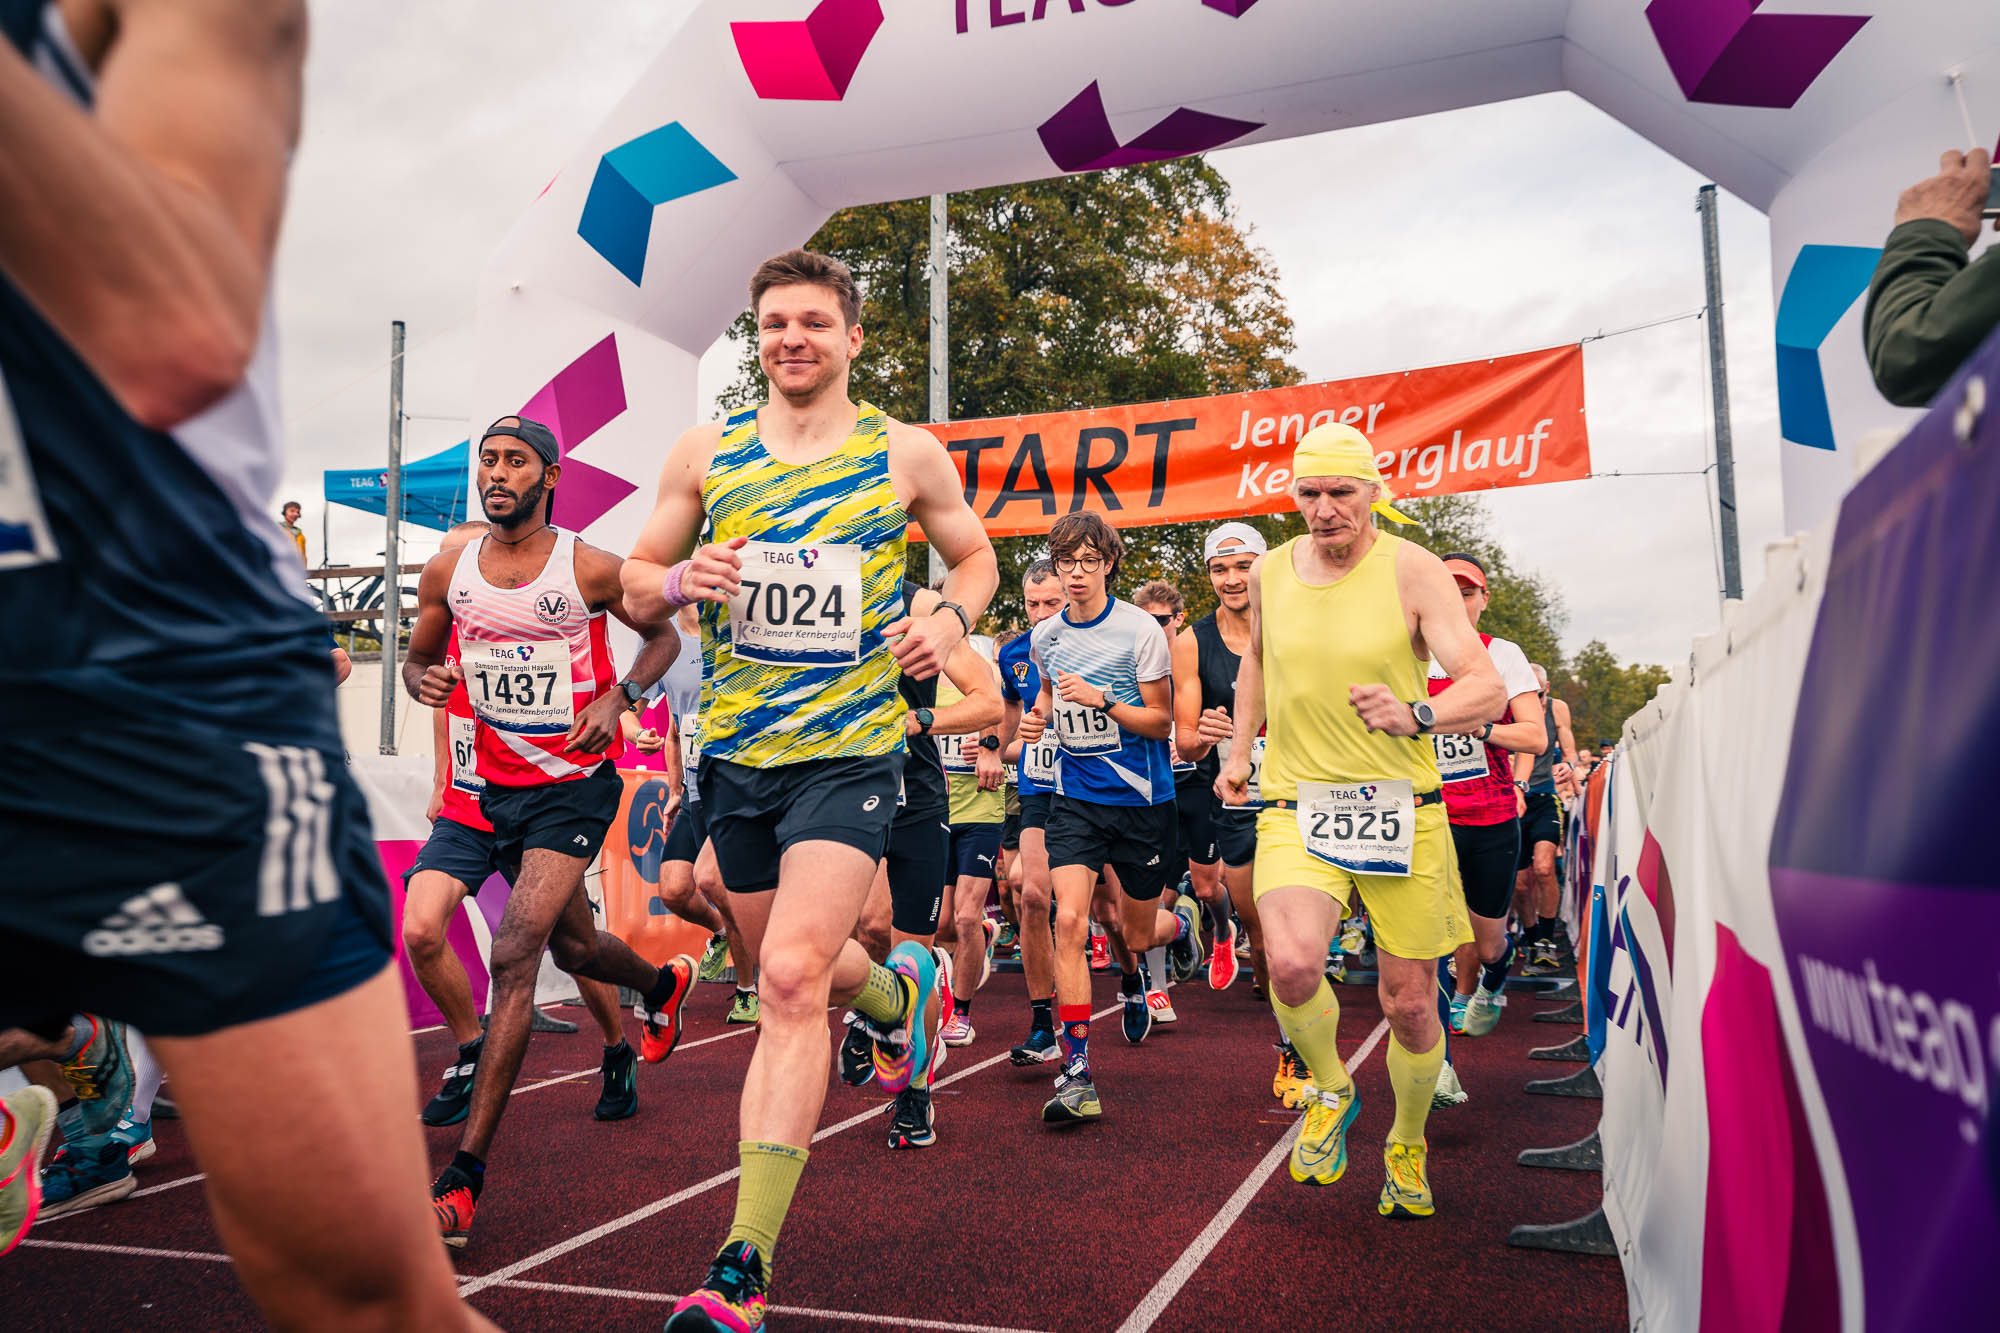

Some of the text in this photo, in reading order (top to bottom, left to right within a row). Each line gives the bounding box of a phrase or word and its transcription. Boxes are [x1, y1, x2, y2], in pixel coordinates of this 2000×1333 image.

[1236, 418, 1553, 500] Keerglauf
[940, 417, 1198, 519] TART
[762, 551, 795, 564] TEAG
[740, 579, 846, 627] 7024
[749, 626, 858, 642] 47. Jenaer Kernberglauf
[489, 648, 515, 660] TEAG
[475, 670, 558, 707] 1437
[495, 706, 519, 715] Jenaer
[519, 706, 570, 718] Kernberglauf
[1043, 730, 1058, 740] EAG
[1329, 790, 1358, 800] TEAG
[1310, 810, 1401, 842] 2525
